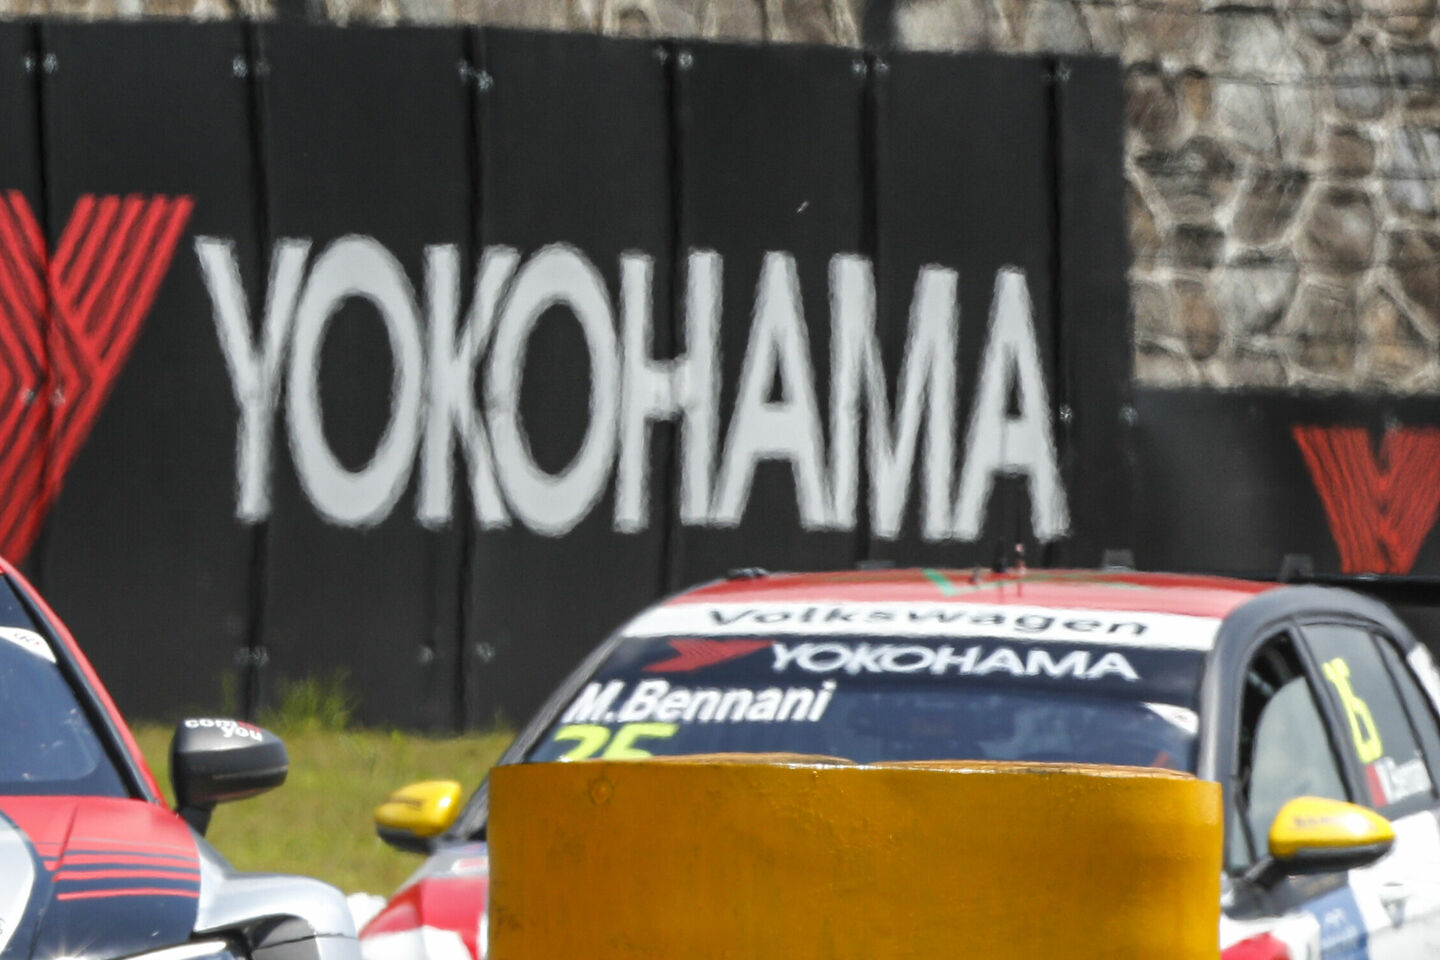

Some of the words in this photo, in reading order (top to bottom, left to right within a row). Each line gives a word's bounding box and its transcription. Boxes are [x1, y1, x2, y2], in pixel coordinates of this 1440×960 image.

[195, 234, 1071, 540] YOKOHAMA
[708, 606, 1150, 637] Volkswagen
[770, 642, 1140, 682] YOKOHAMA
[561, 679, 838, 723] M.Bennani
